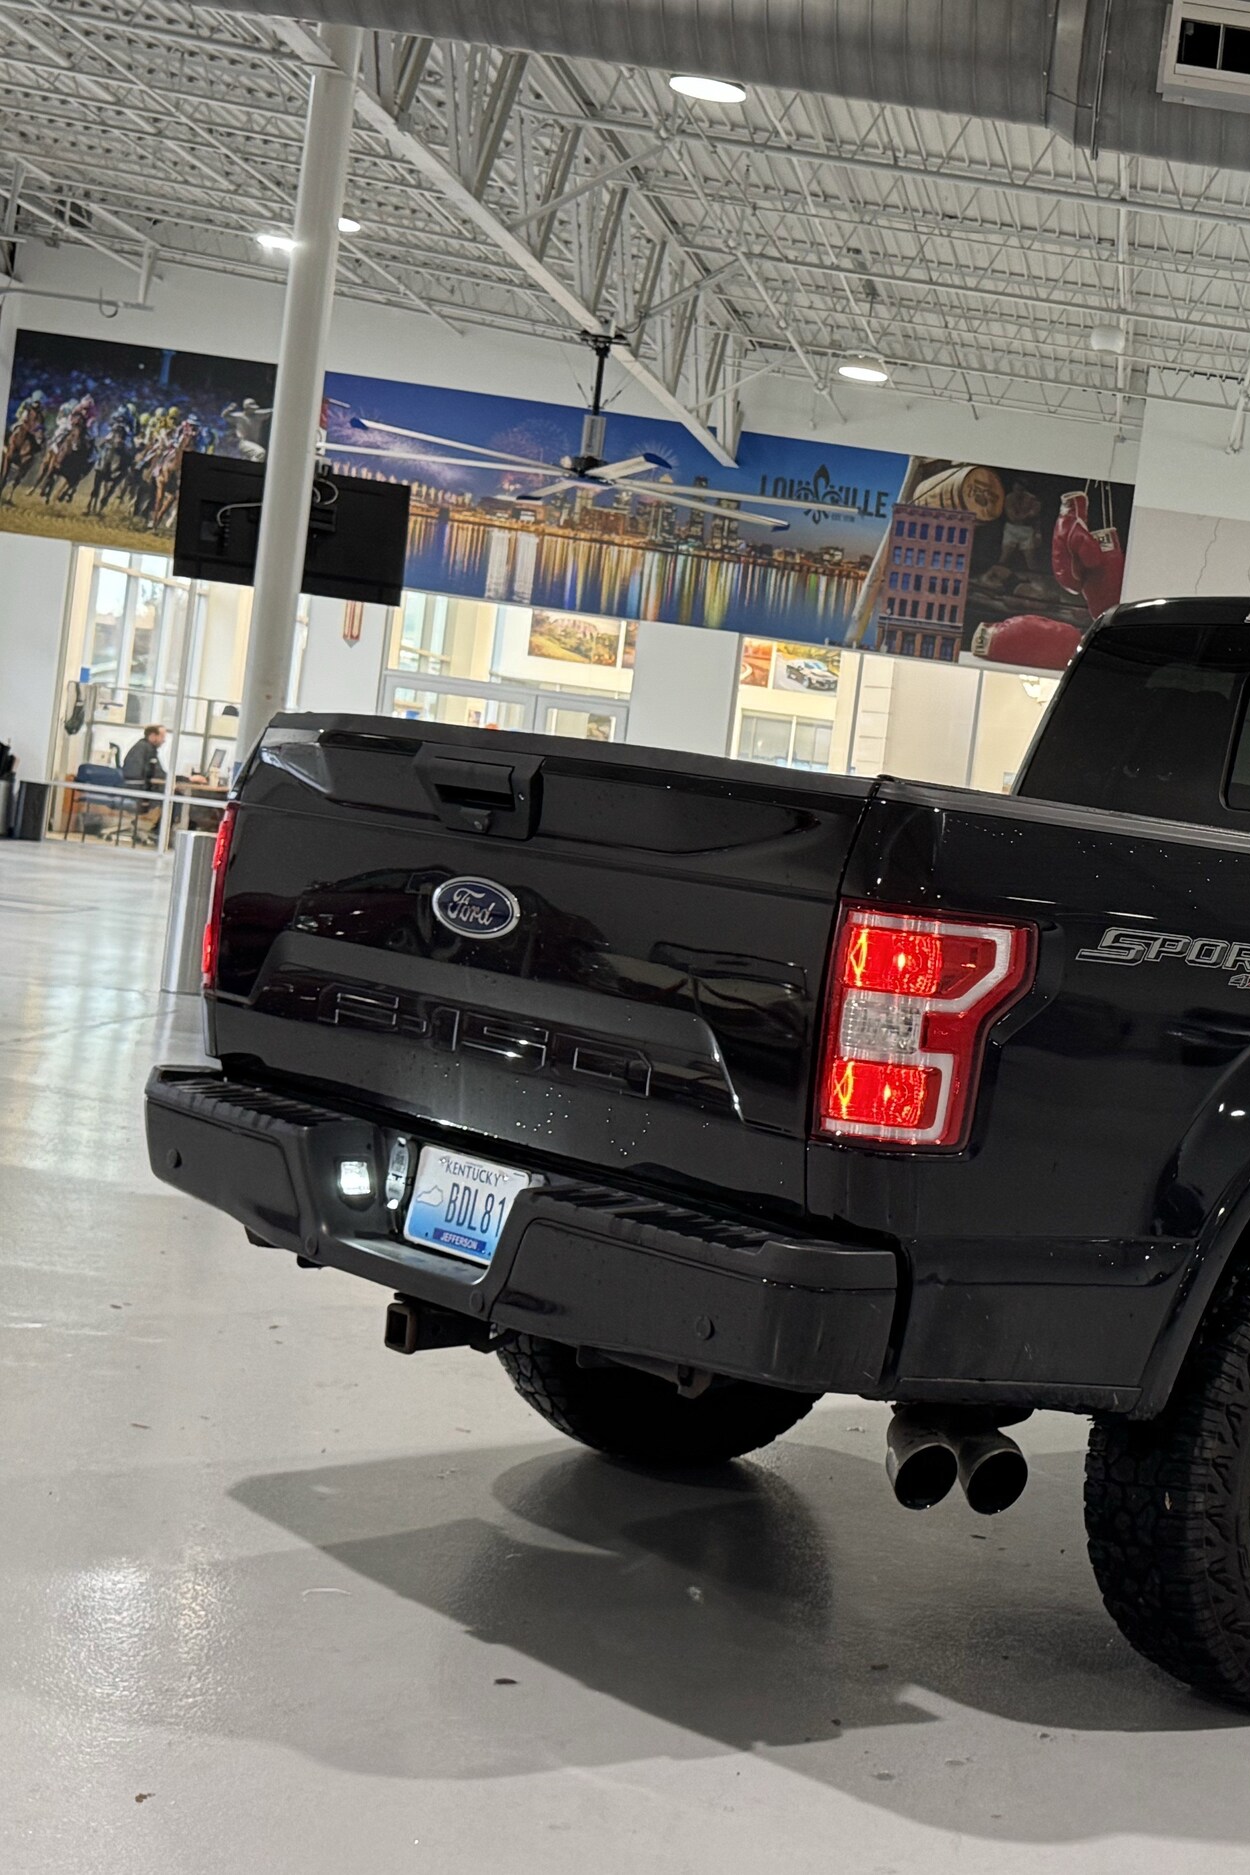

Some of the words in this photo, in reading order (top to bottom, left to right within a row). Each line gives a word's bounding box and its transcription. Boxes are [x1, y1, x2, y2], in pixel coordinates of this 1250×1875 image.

[449, 886, 497, 927] Ford
[445, 1160, 501, 1187] KENTUCKY
[440, 1231, 479, 1250] JEFFERSON
